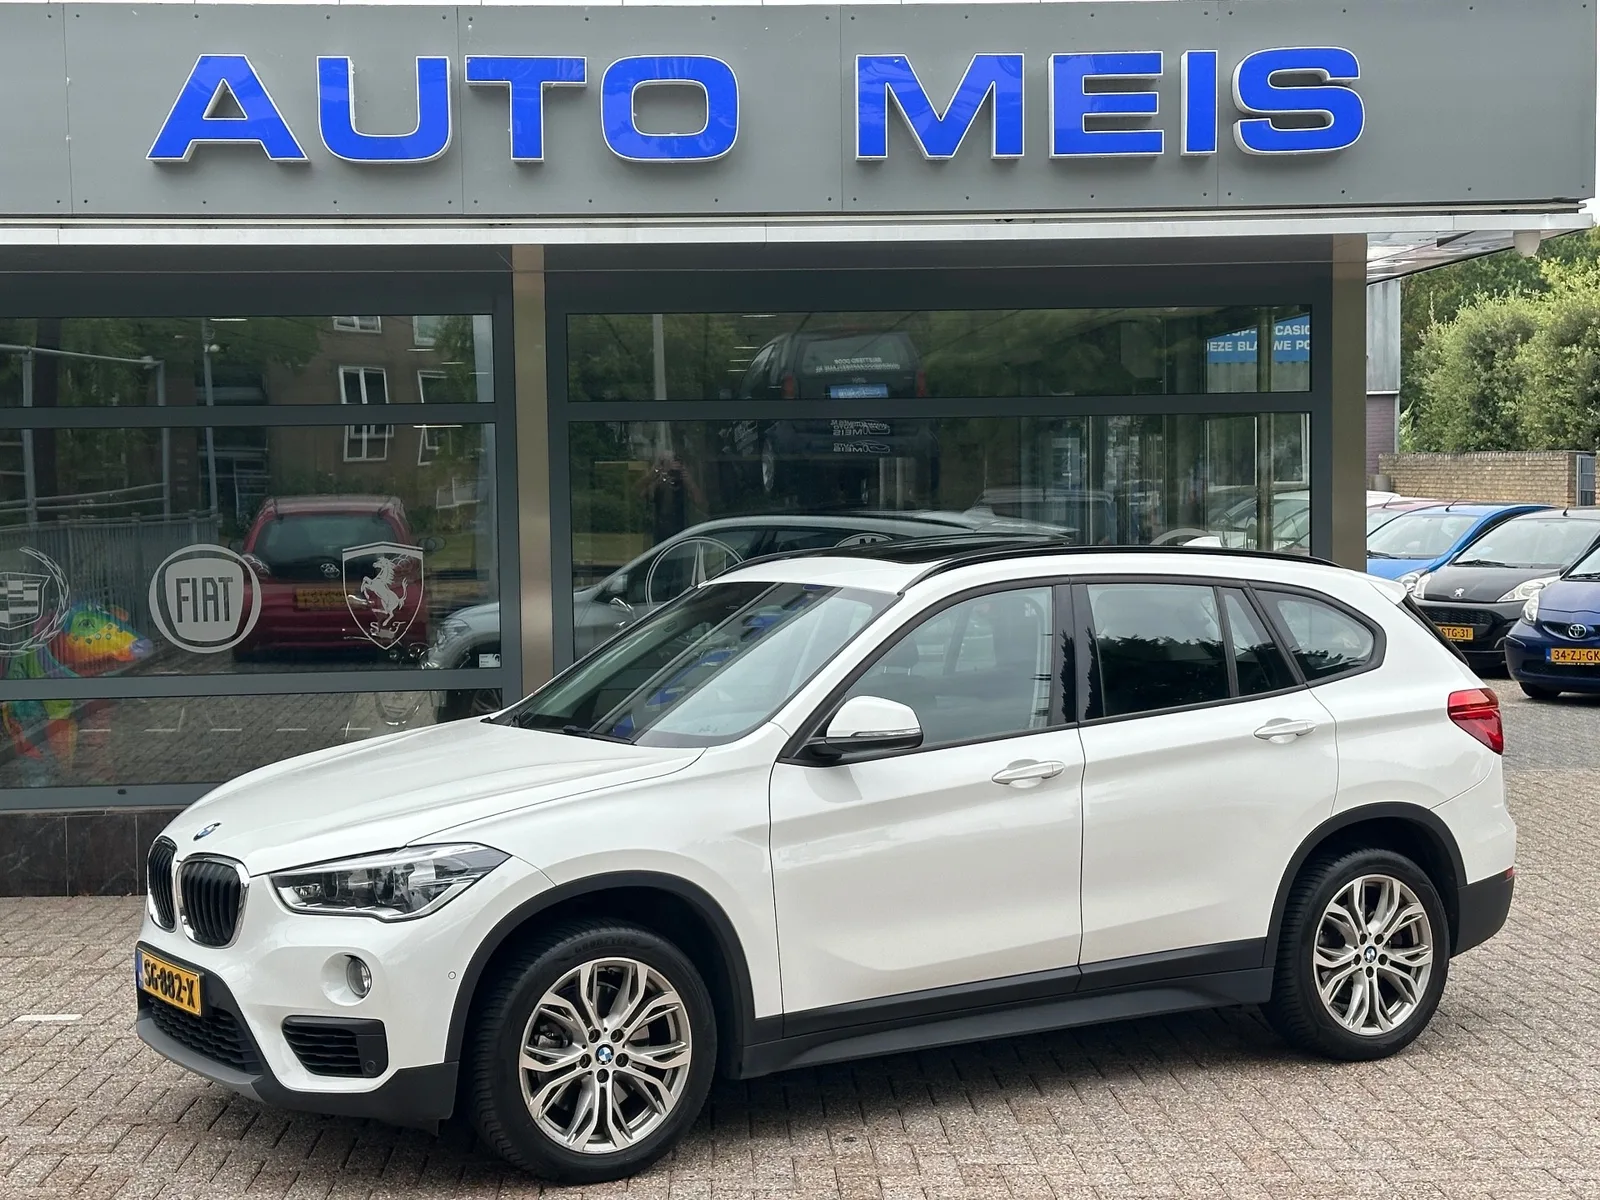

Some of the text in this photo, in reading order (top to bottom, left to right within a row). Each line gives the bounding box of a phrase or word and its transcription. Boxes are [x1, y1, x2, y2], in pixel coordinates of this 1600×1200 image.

[145, 45, 1366, 164] AUTO MEIS
[175, 576, 233, 623] FIAT
[1554, 649, 1600, 661] 34-ZJ-GK
[144, 958, 196, 1009] SG-882-X
